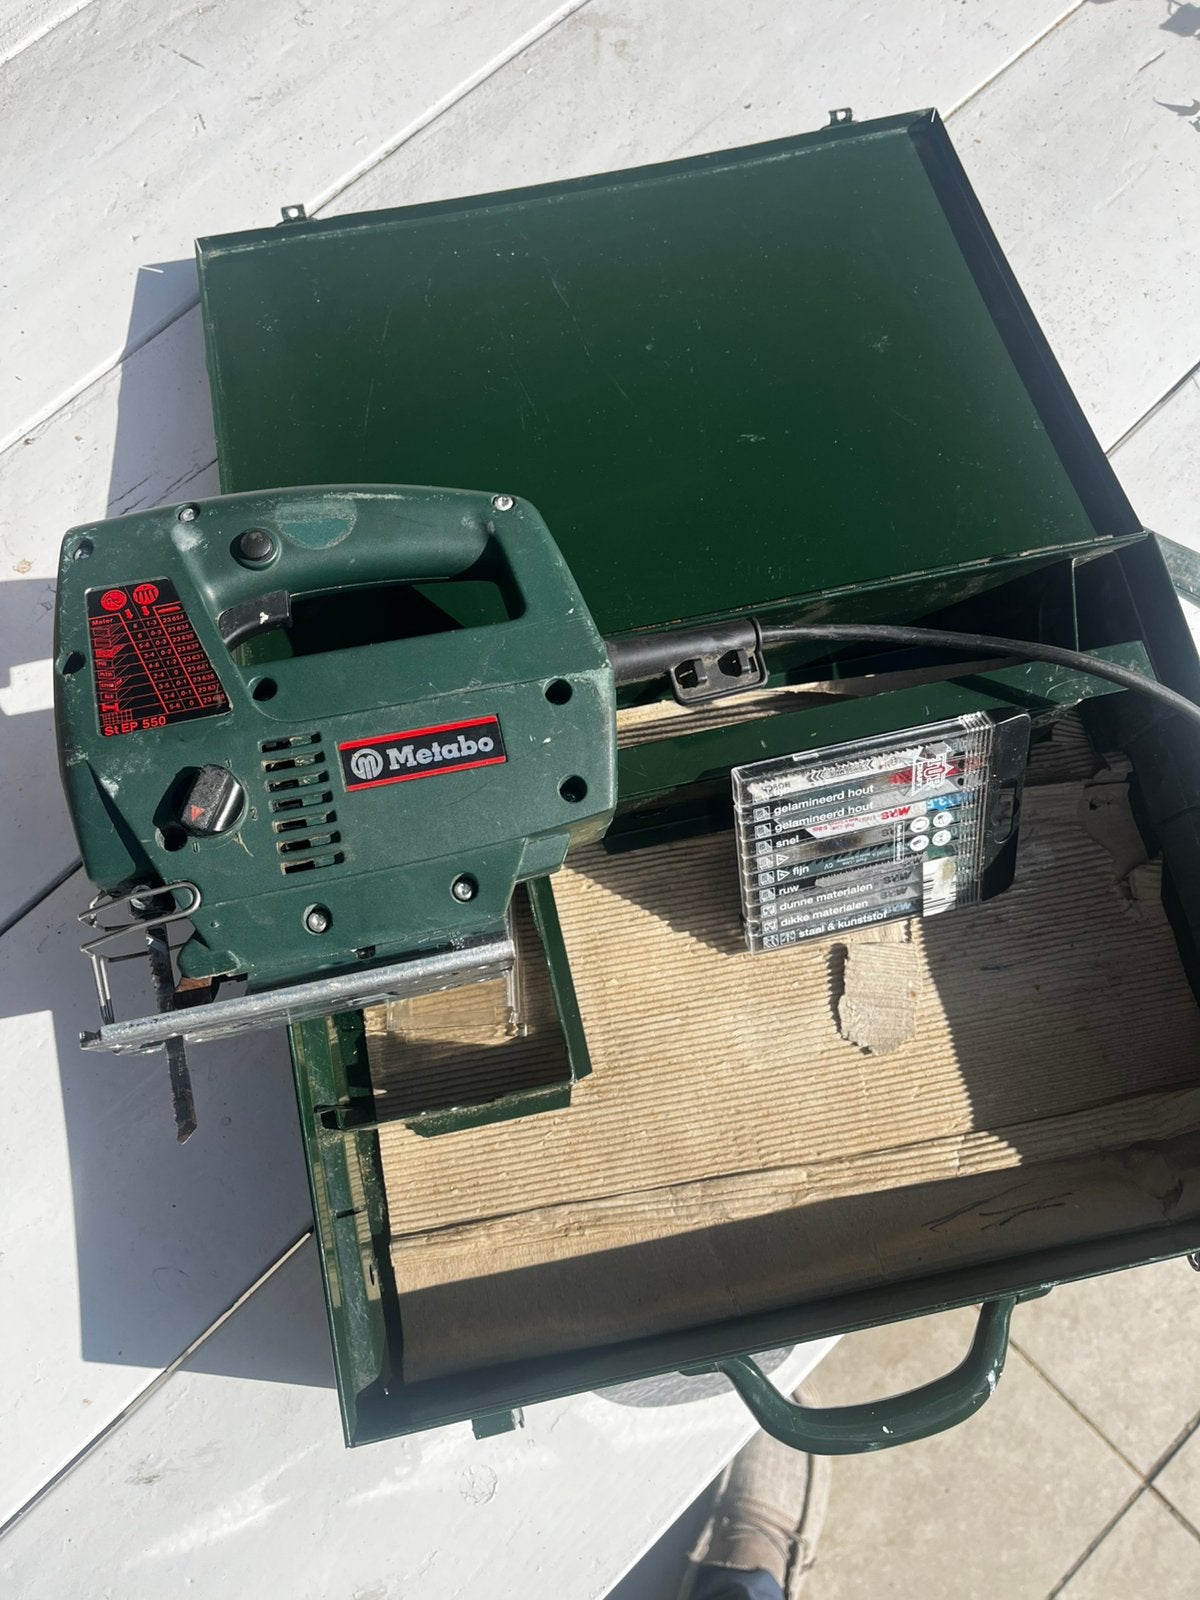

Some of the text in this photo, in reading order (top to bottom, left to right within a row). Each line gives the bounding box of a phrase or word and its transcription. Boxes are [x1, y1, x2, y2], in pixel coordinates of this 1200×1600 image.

[121, 721, 138, 733] EP
[142, 715, 166, 729] 550
[386, 735, 494, 770] Metabo
[773, 785, 874, 817] gelamineerd hout
[774, 808, 845, 833] gelamineerd
[848, 802, 874, 815] hout
[775, 835, 799, 848] snel
[792, 865, 809, 877] fijn
[778, 884, 800, 896] ruw
[779, 883, 873, 911] dunne materialen
[780, 900, 869, 928] dikke materialen
[798, 910, 888, 938] staal & kunststof
